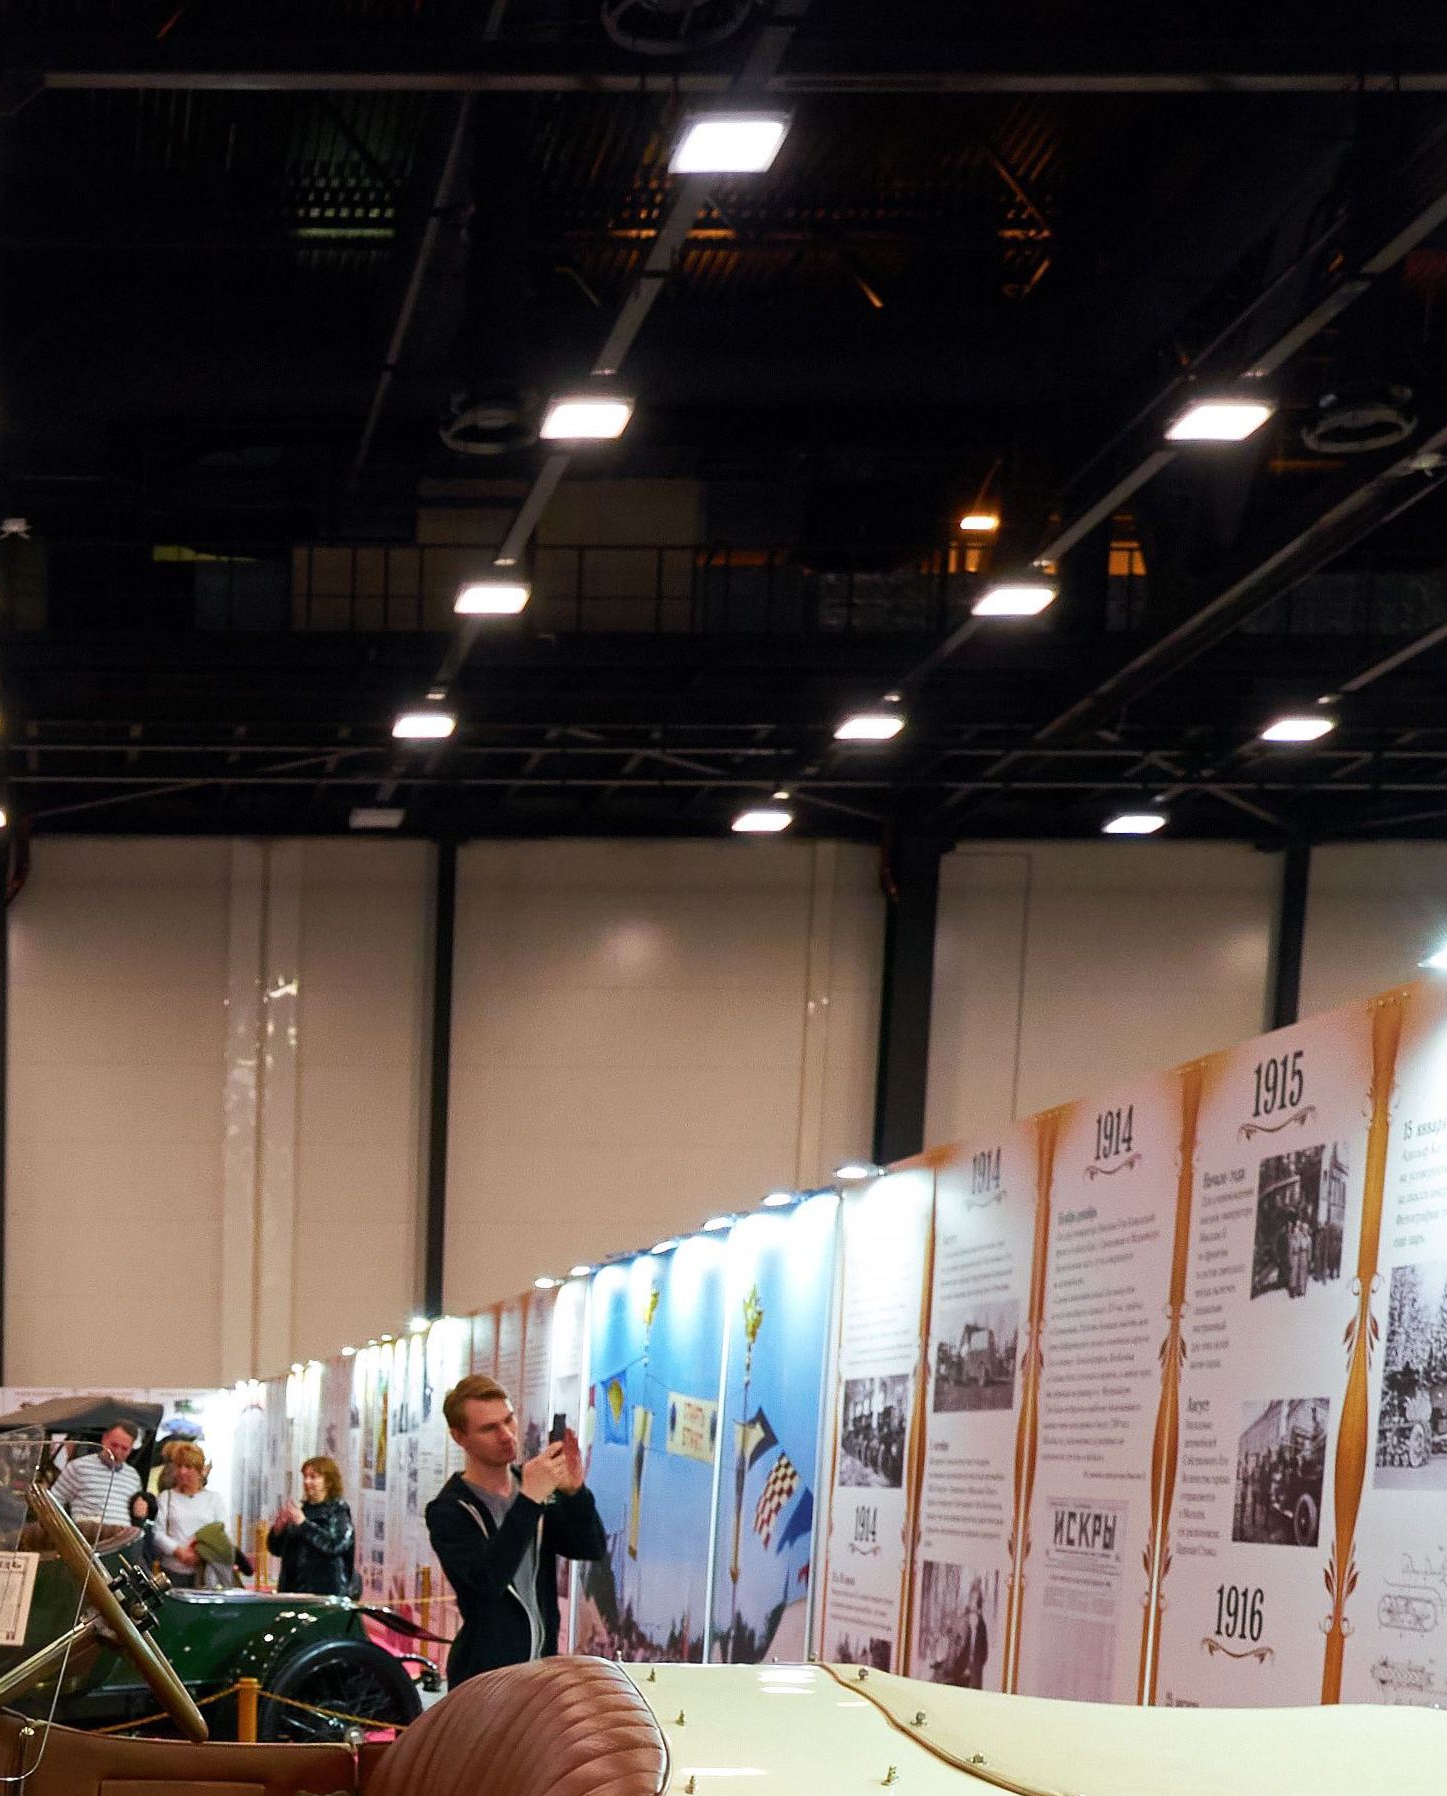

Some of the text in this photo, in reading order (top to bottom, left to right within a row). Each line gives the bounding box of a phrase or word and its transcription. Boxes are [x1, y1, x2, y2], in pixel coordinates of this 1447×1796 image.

[1252, 1050, 1304, 1117] 1915
[1095, 1104, 1134, 1160] 1914
[972, 1147, 1001, 1195] 1914
[854, 1505, 877, 1542] 1914
[1053, 1510, 1117, 1551] ИСКРЫ
[1215, 1583, 1263, 1641] 1916
